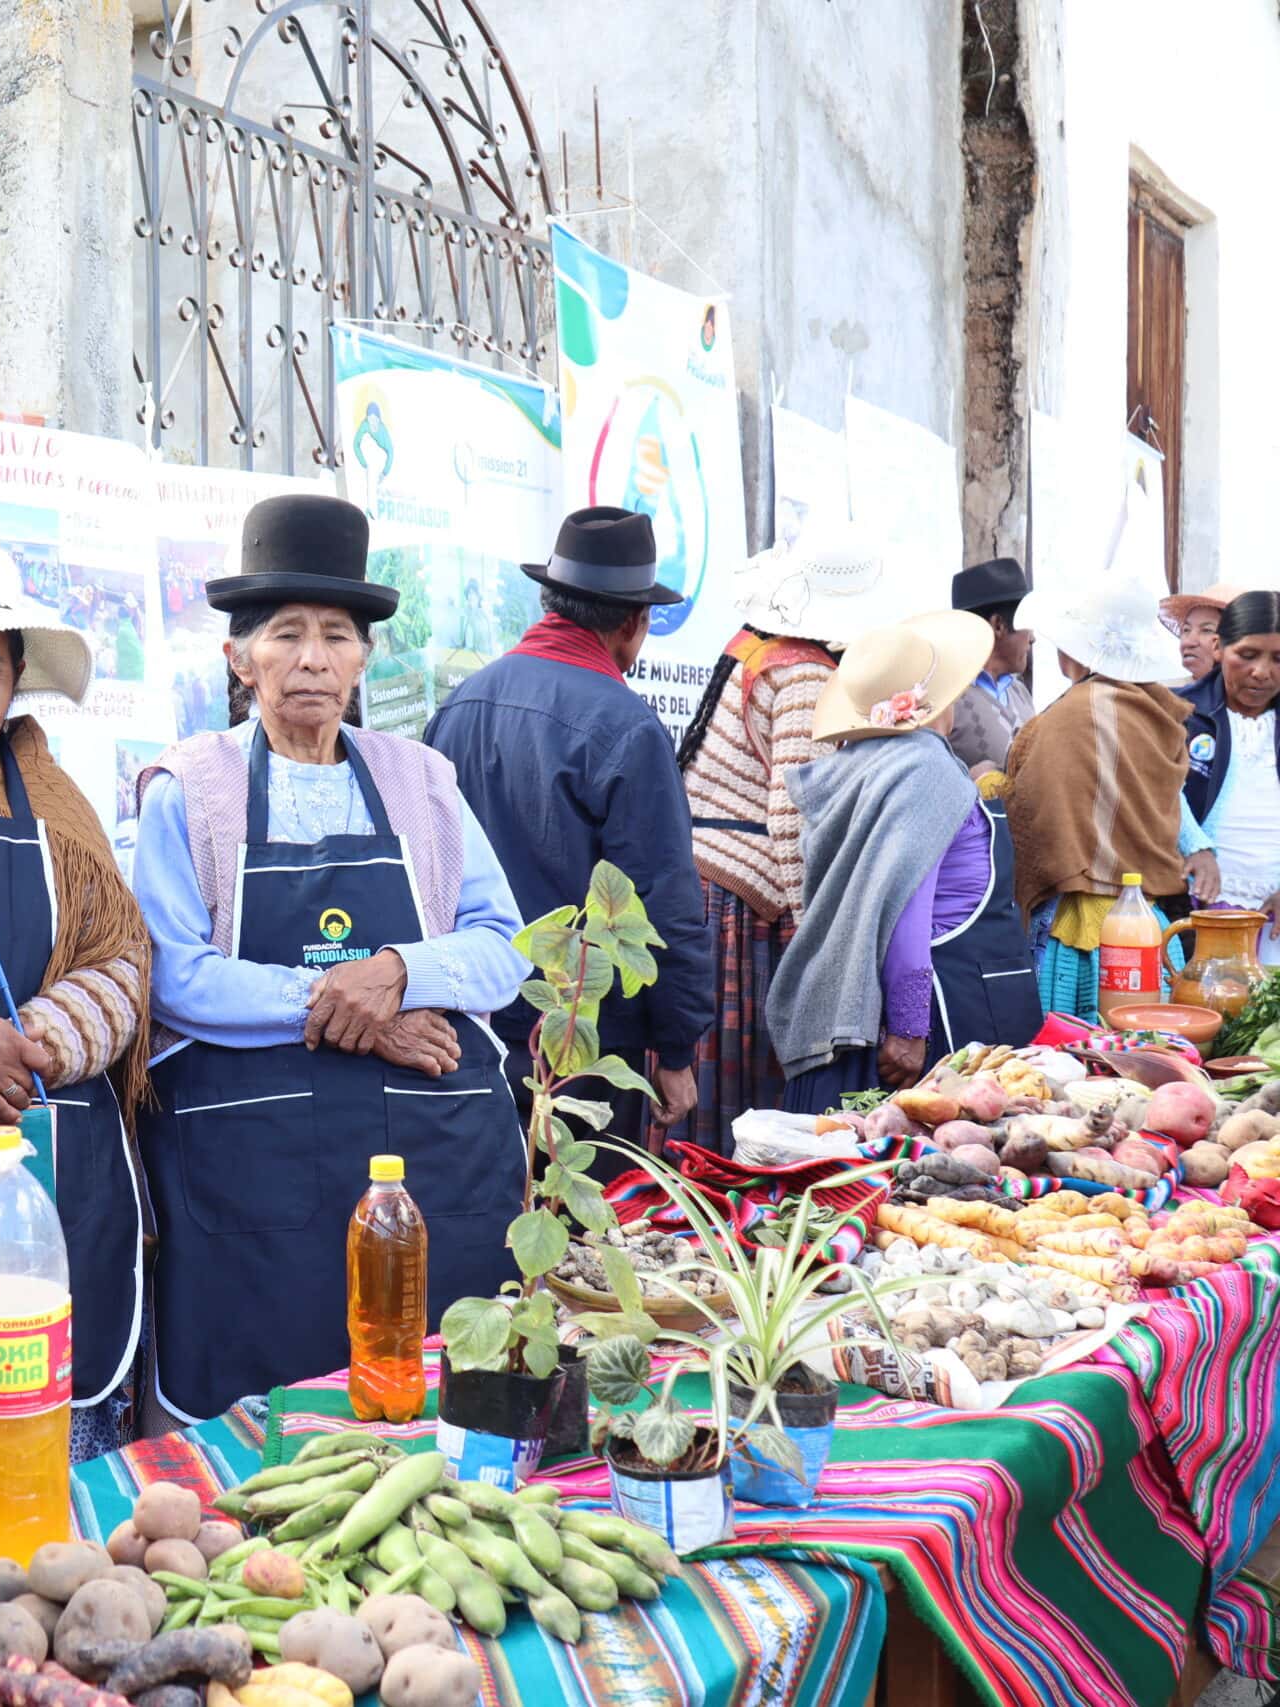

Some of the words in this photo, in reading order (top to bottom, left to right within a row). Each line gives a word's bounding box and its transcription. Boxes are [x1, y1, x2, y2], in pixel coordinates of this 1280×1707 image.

[517, 459, 528, 478] 21
[650, 661, 713, 686] MUJERES
[371, 685, 408, 704] Sistemas
[669, 696, 691, 716] DEL
[303, 948, 371, 964] PRODIASUR
[480, 1465, 512, 1486] UHT
